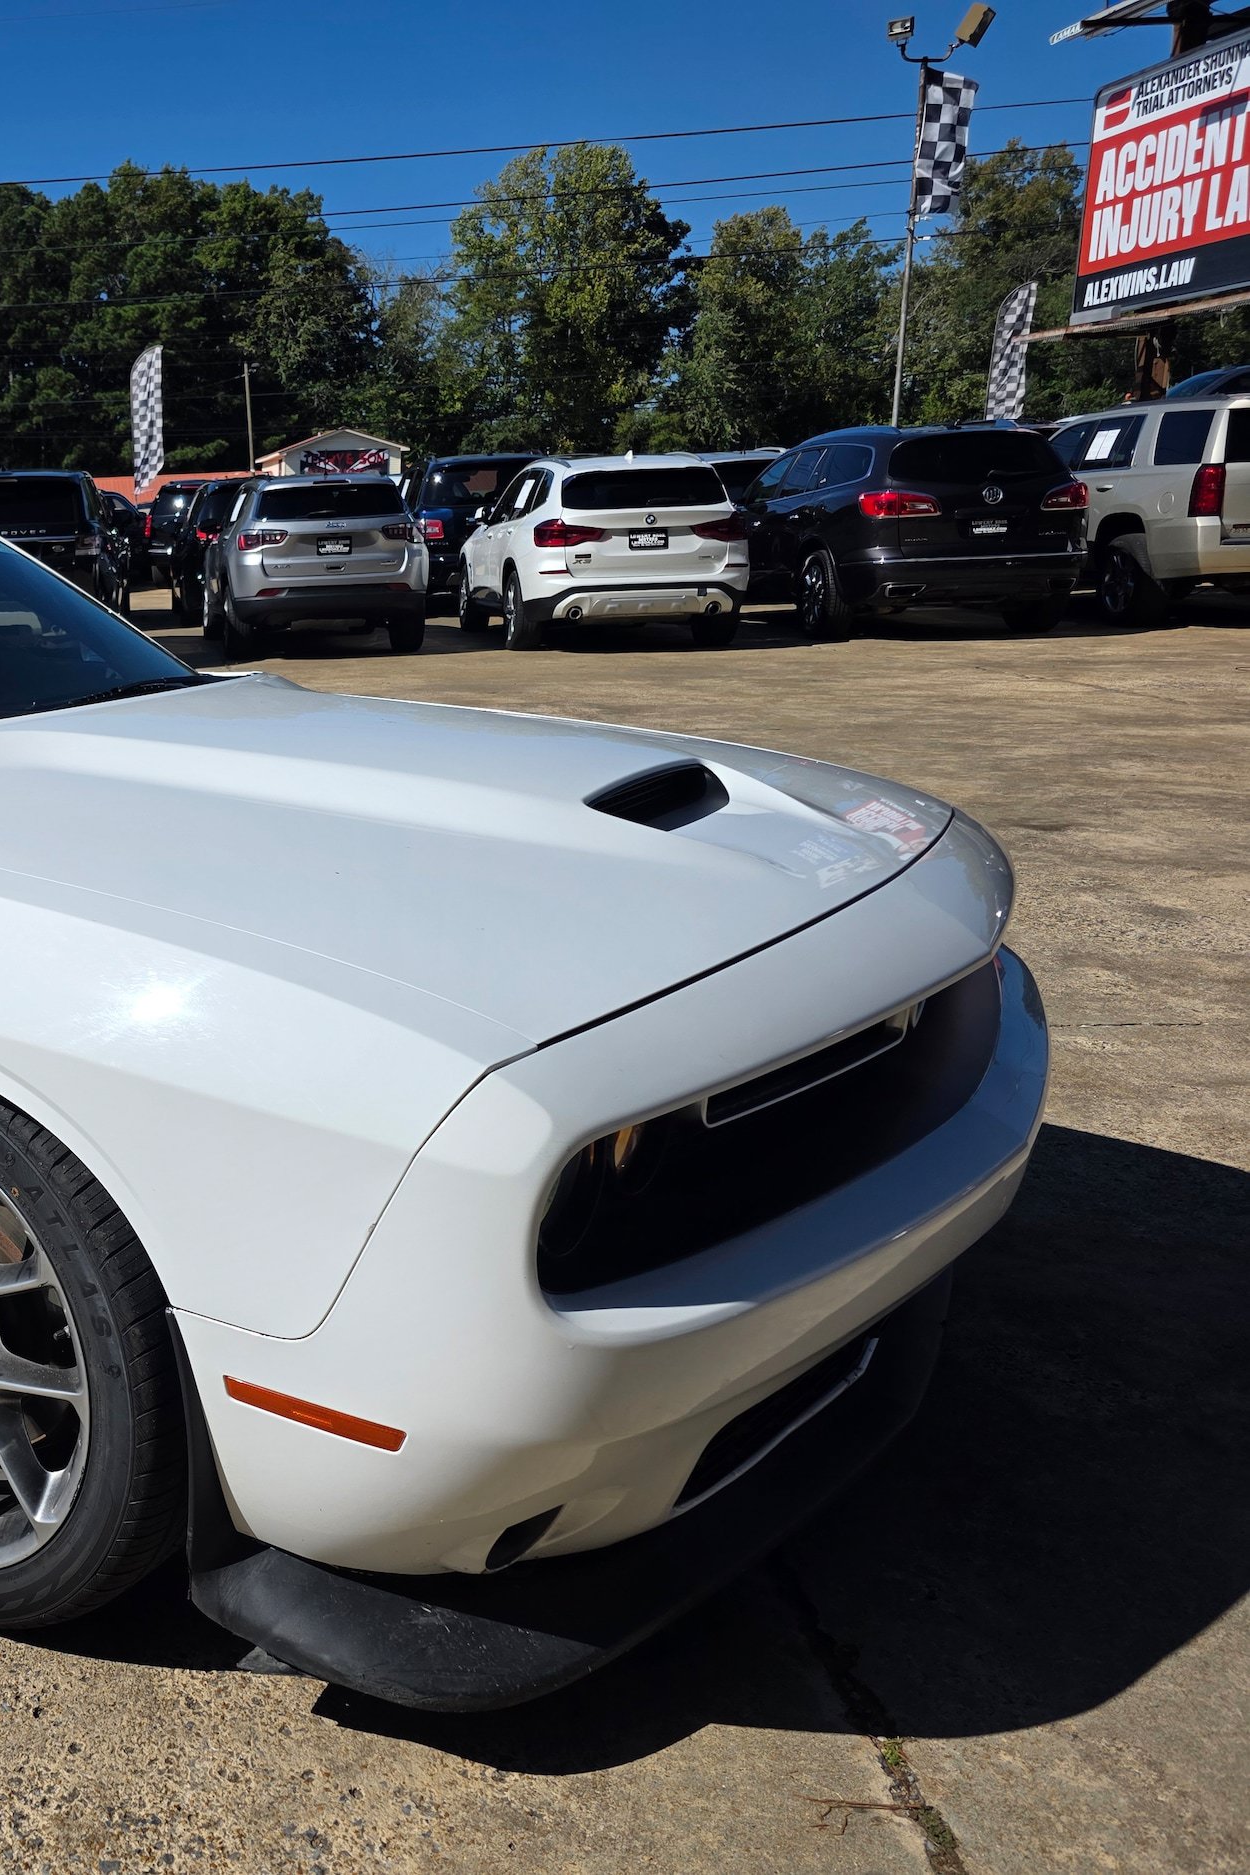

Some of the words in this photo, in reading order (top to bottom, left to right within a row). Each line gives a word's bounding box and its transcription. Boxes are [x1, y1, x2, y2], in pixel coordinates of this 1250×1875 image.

[1136, 93, 1165, 119] TRIAL
[1166, 66, 1233, 107] ATTORNEYS
[1137, 59, 1202, 100] ALEXANDER
[1095, 102, 1250, 205] ACCIDENT
[1088, 178, 1204, 262] INJURY
[1205, 165, 1250, 232] LA
[1083, 257, 1196, 307] ALEXWINS.LAW
[23, 1184, 112, 1338] ATLAS
